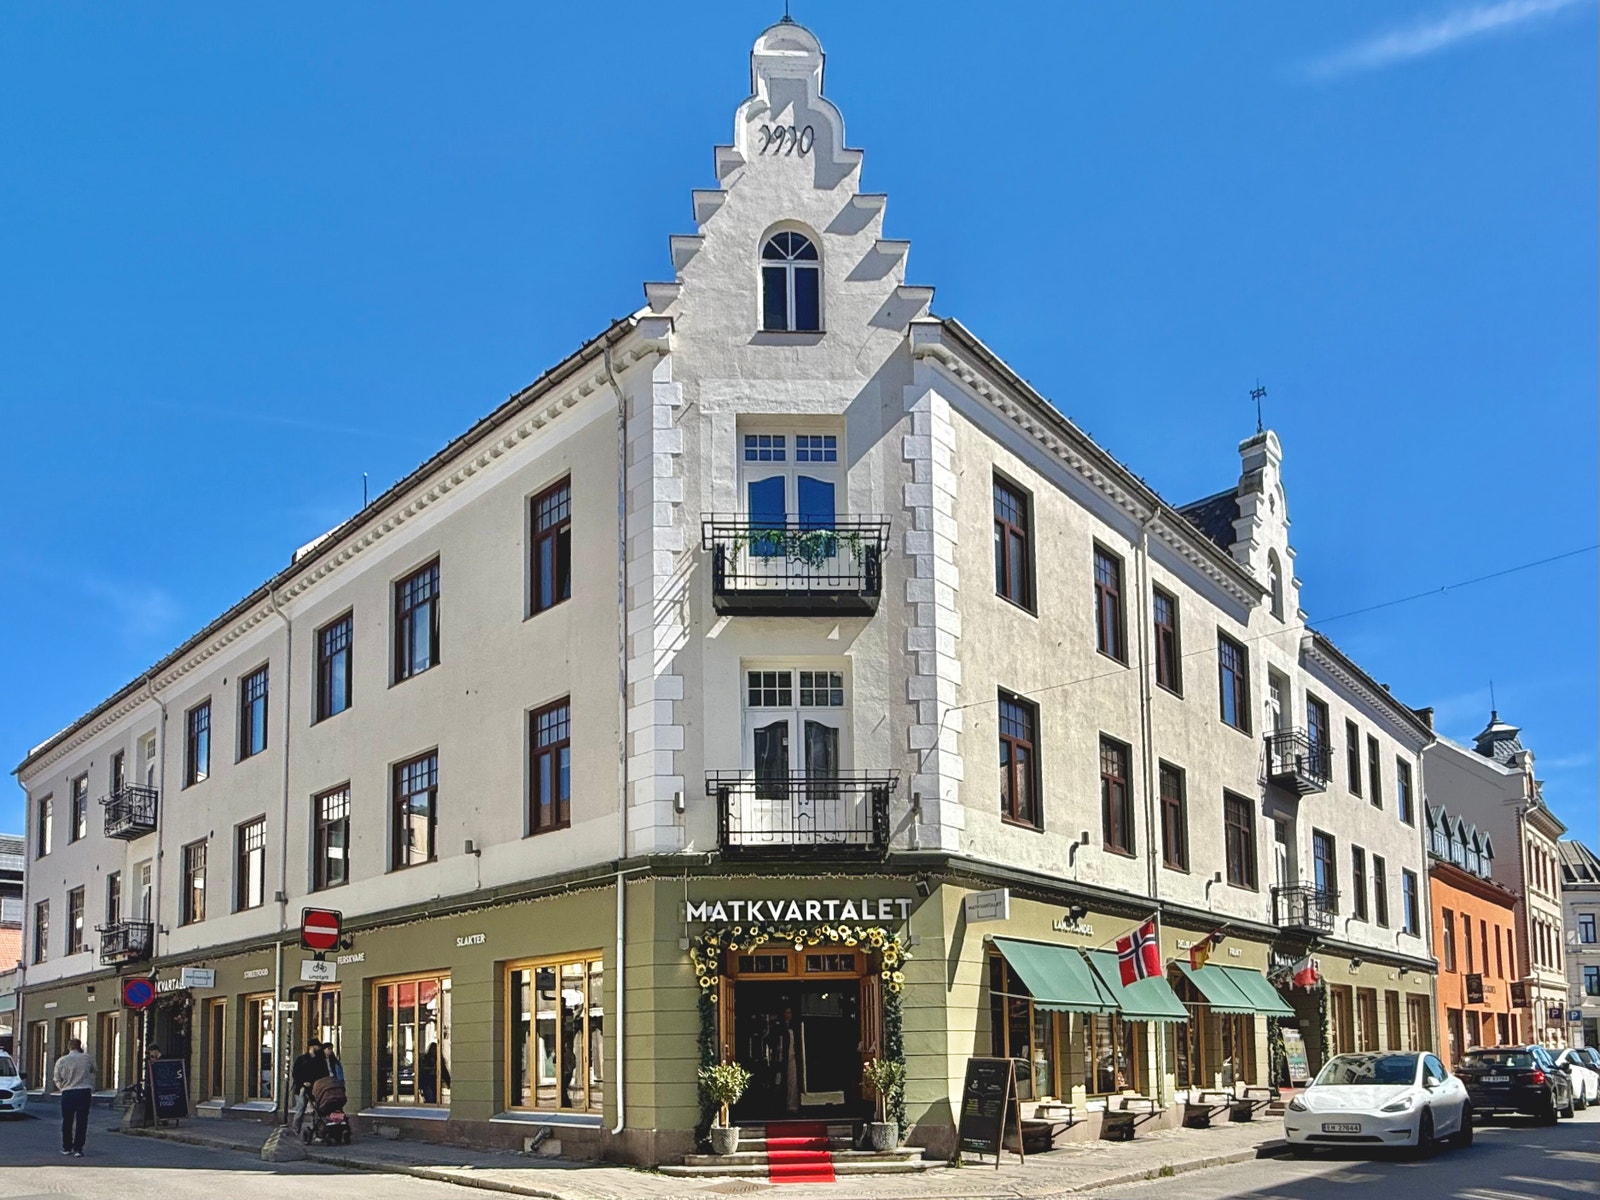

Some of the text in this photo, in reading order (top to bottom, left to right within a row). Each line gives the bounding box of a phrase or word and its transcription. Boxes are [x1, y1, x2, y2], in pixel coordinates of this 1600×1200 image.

[686, 898, 913, 922] MATKVARTALET
[456, 933, 486, 947] SLAKTER
[1551, 1009, 1560, 1018] P
[1571, 1011, 1578, 1019] P
